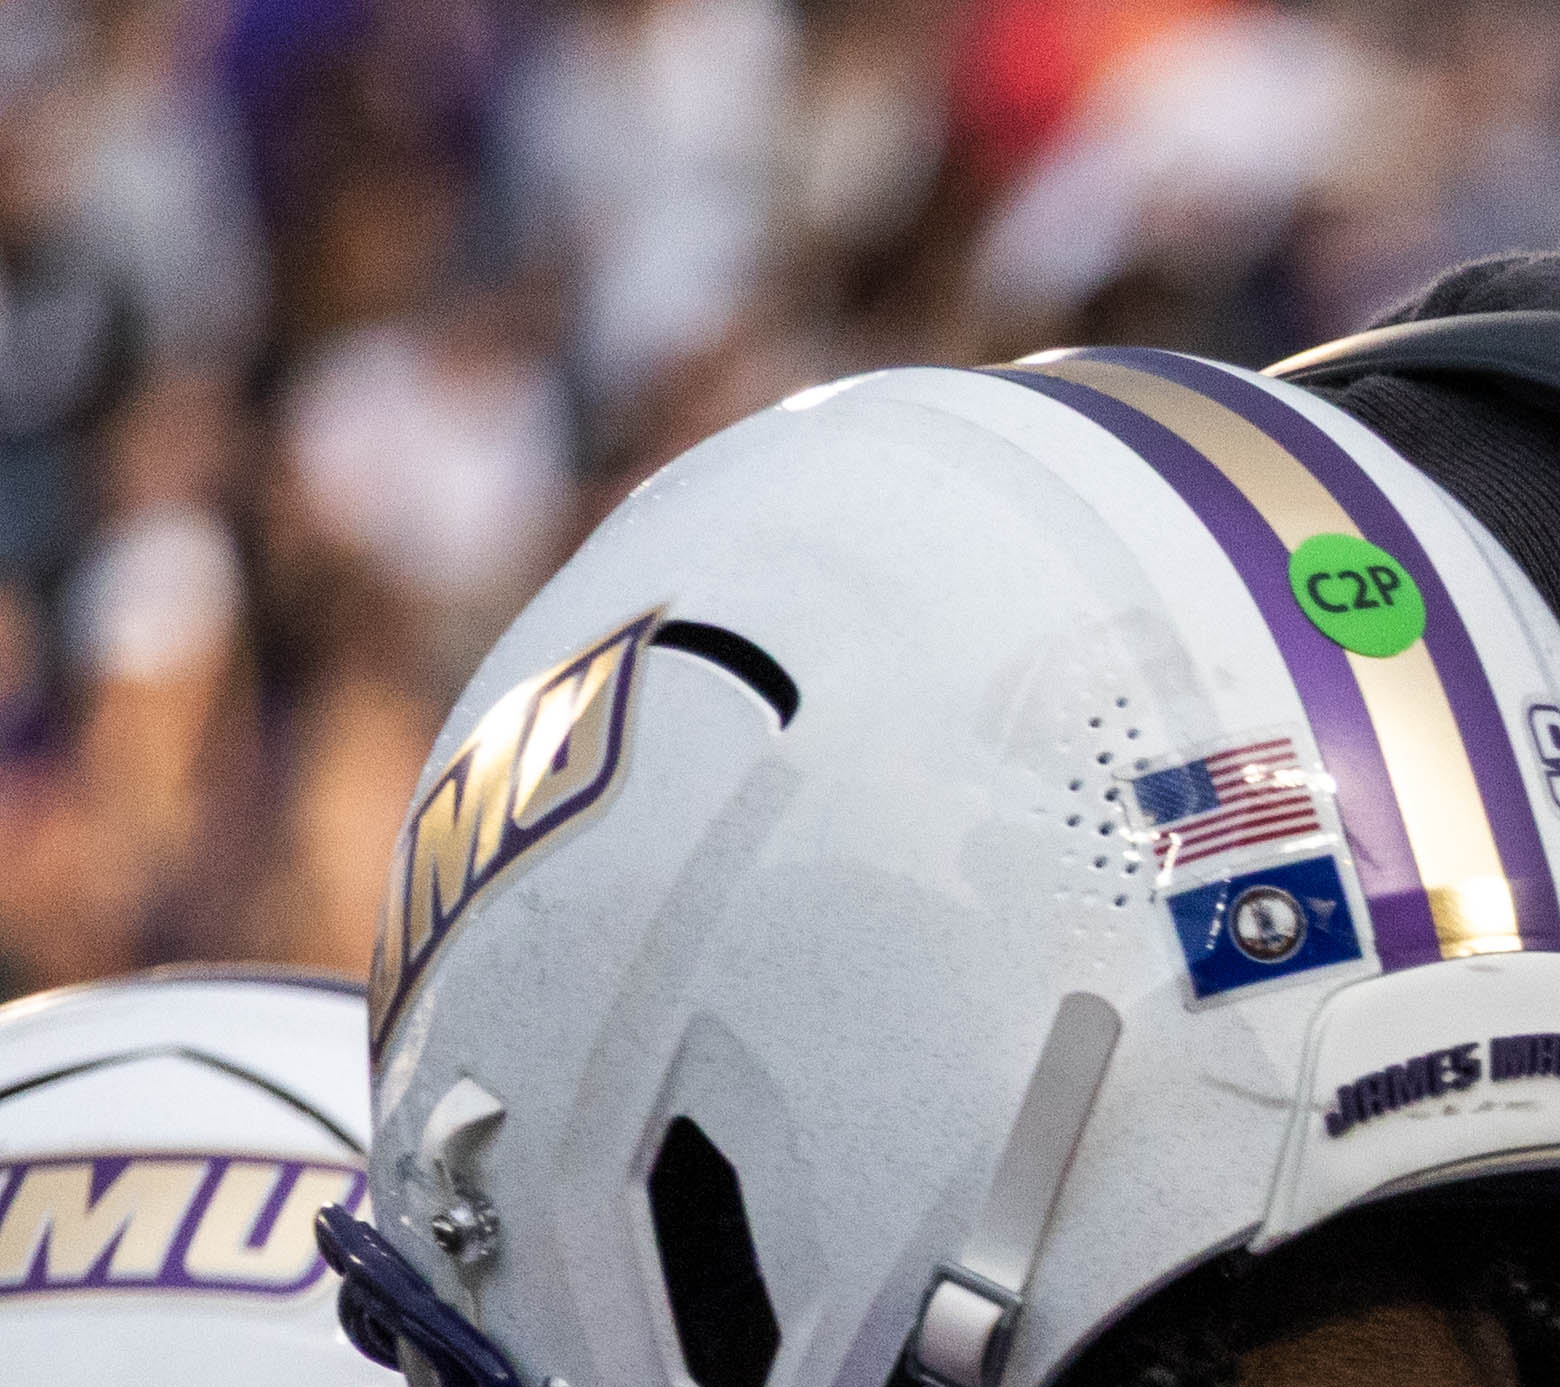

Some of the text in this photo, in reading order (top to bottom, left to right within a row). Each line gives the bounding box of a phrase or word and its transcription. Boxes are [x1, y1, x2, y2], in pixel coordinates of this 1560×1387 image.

[1307, 565, 1400, 614] C2P
[370, 610, 655, 1062] MU
[1324, 1042, 1481, 1137] JAMES
[0, 1155, 365, 1293] MU
